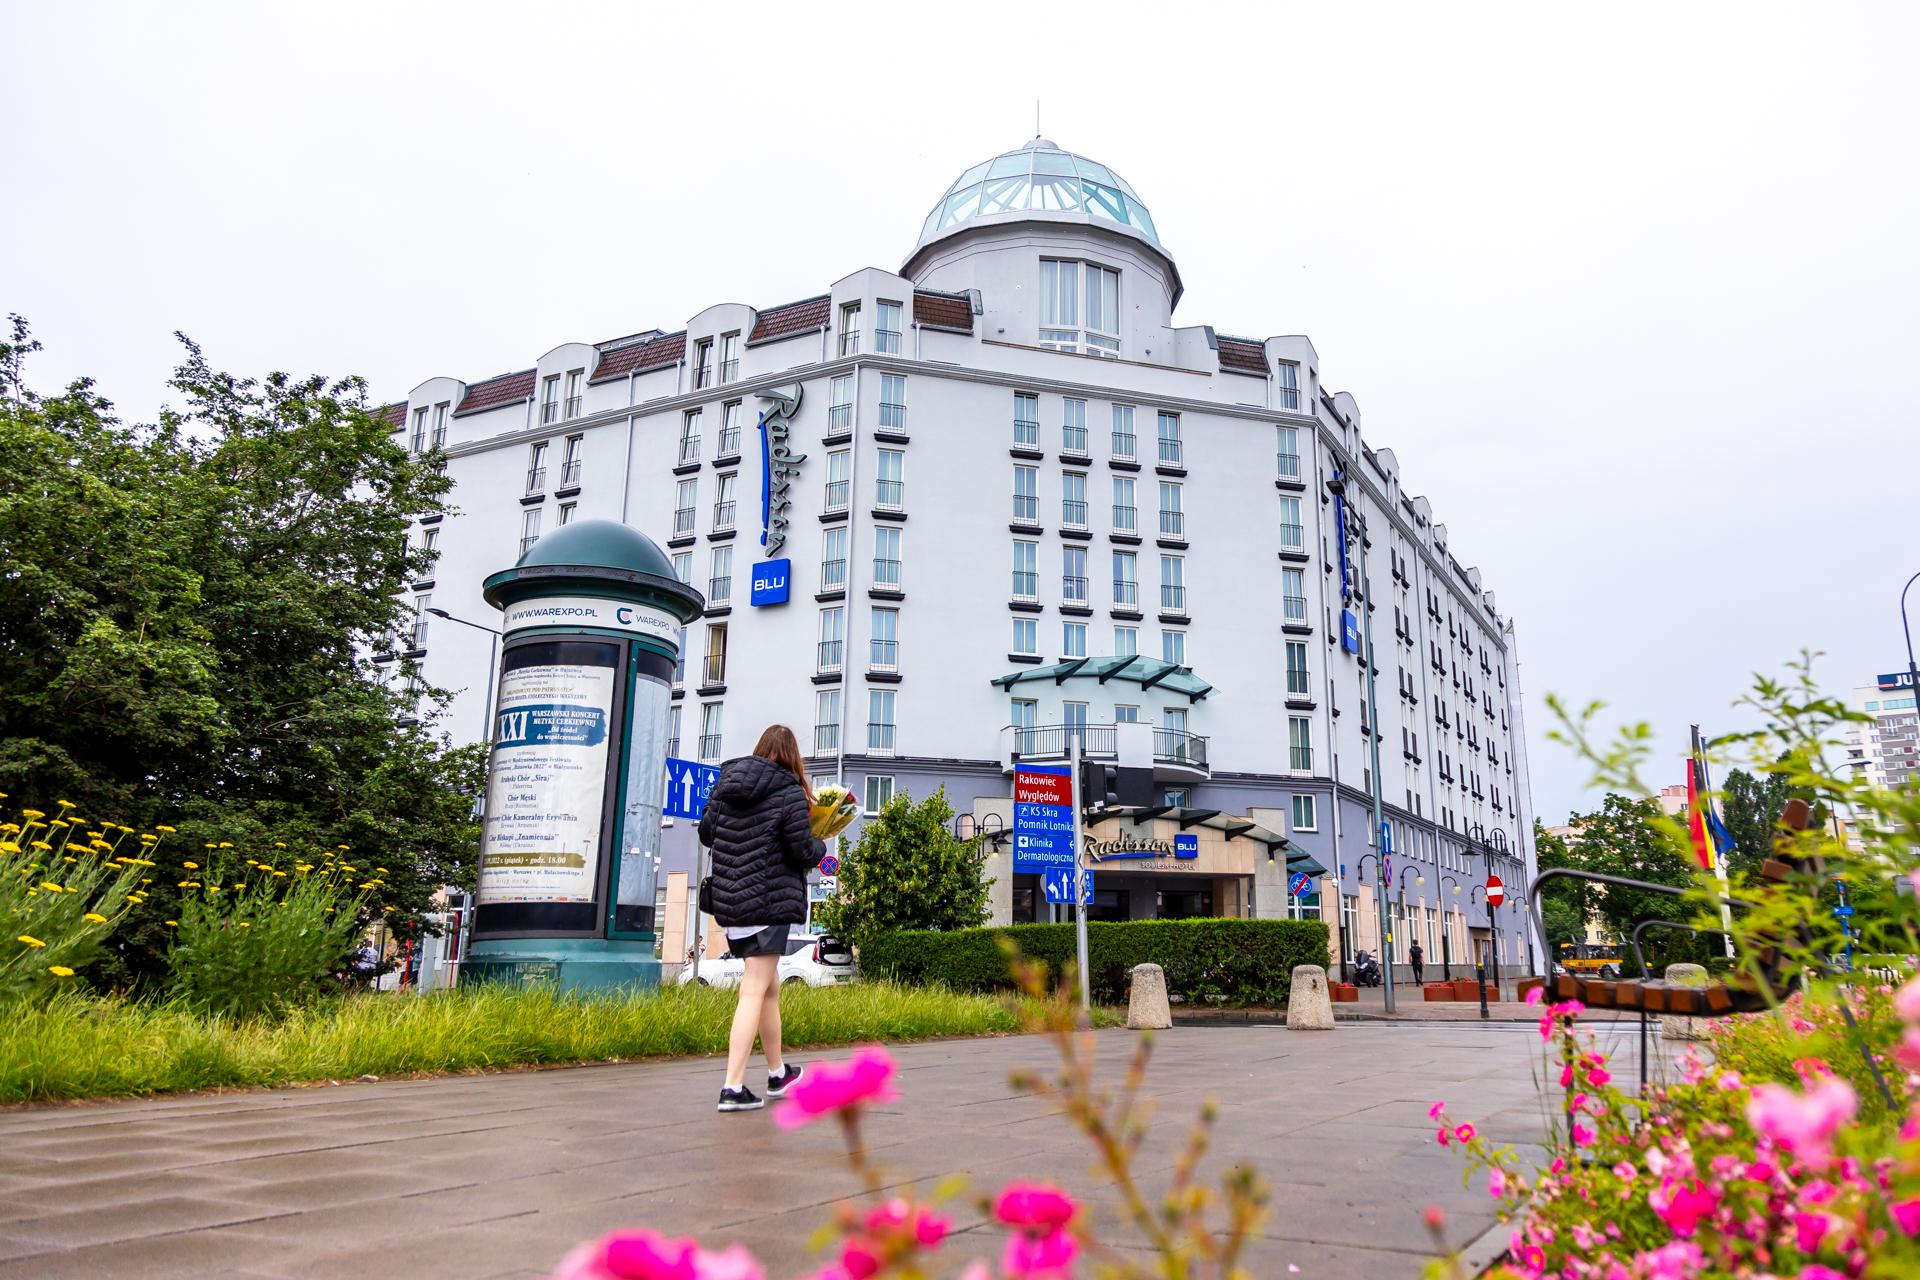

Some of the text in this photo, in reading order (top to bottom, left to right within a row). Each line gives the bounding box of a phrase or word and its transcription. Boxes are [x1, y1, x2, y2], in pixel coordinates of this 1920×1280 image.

[754, 382, 807, 558] Radisson
[754, 576, 785, 592] BLU
[512, 608, 598, 621] WWW.WAREXPO.PL
[635, 614, 670, 631] WAREXPO
[532, 710, 570, 719] WARSZAWSKI
[570, 711, 601, 720] KONCERT
[1019, 774, 1056, 787] Rakowiec
[1019, 790, 1060, 803] Wyględów
[1030, 807, 1058, 818] KS Skra
[1018, 819, 1048, 830] Pomnik
[1029, 838, 1053, 848] Klinika
[1083, 828, 1197, 862] Radisson BLU
[1017, 850, 1074, 864] Dermatologiczna
